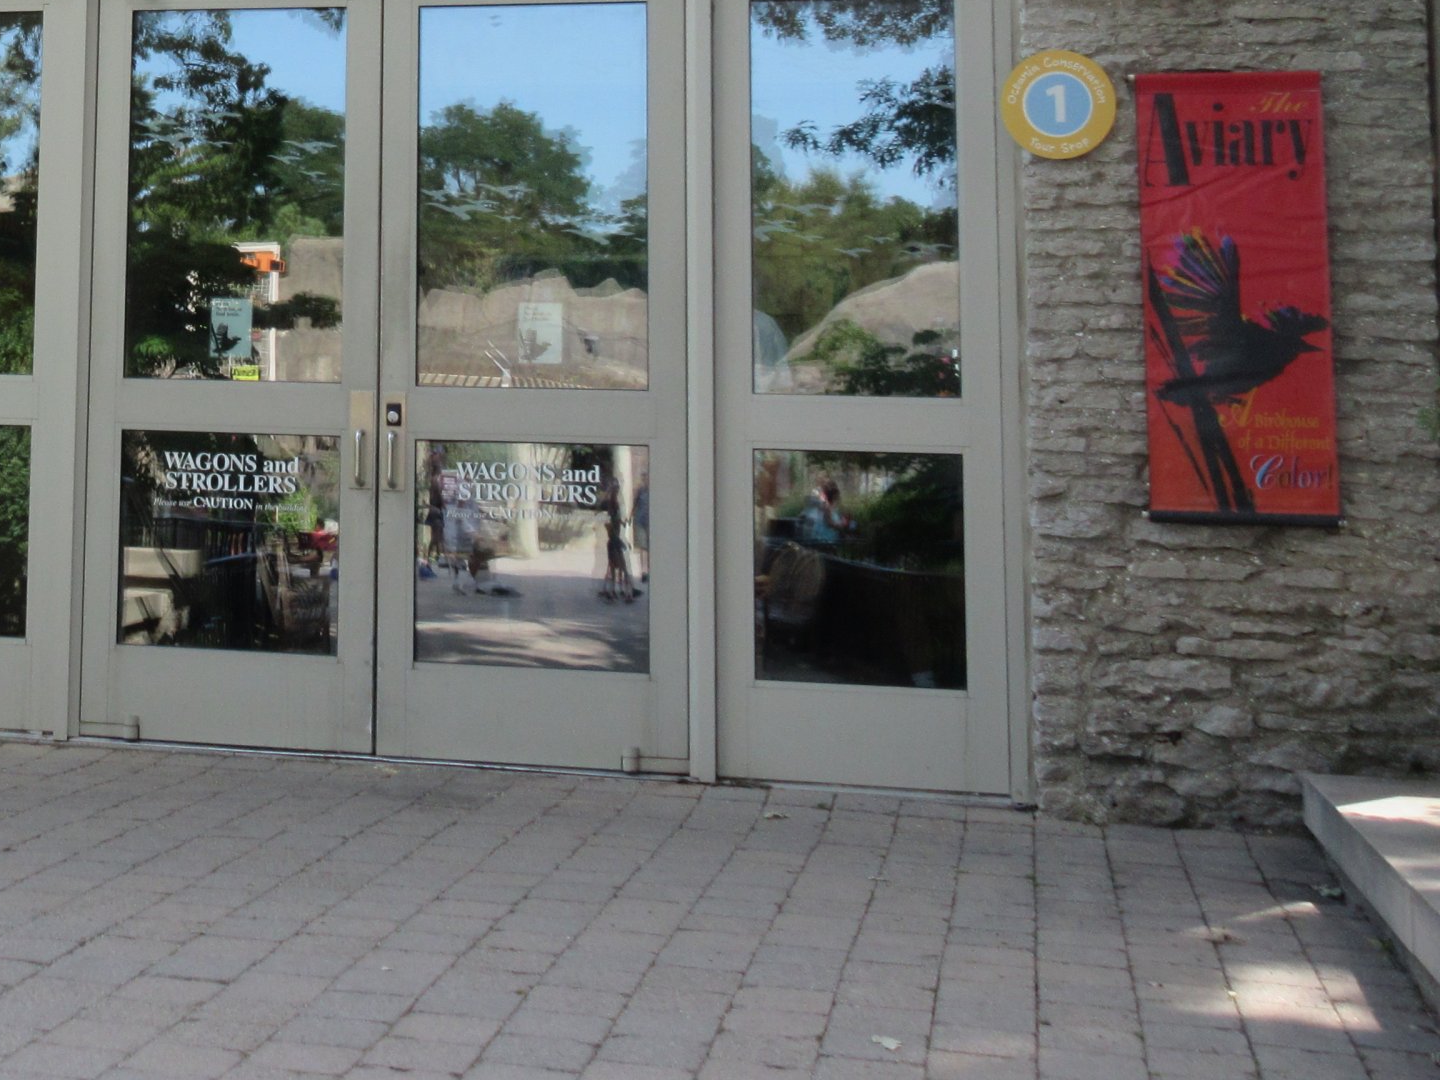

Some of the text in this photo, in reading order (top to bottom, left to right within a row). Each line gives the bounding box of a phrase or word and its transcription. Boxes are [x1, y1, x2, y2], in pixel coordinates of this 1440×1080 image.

[1043, 57, 1106, 104] Conservation
[1045, 83, 1067, 123] 1
[1250, 91, 1308, 113] The
[1031, 136, 1089, 154] Tour Stop
[1145, 92, 1312, 187] Aviary
[1255, 407, 1320, 428] Birdhouse
[1238, 429, 1251, 451] of
[1266, 427, 1331, 451] Different
[164, 450, 300, 474] WAGONS and
[456, 461, 601, 483] WAGONS and
[1250, 454, 1333, 490] Color!
[165, 471, 298, 495] STROLLERS
[457, 482, 599, 506] STROLLERS
[153, 497, 178, 507] Please
[193, 496, 255, 511] CAUTION
[264, 502, 277, 512] the
[445, 508, 472, 519] Please
[488, 506, 554, 521] CAUTION
